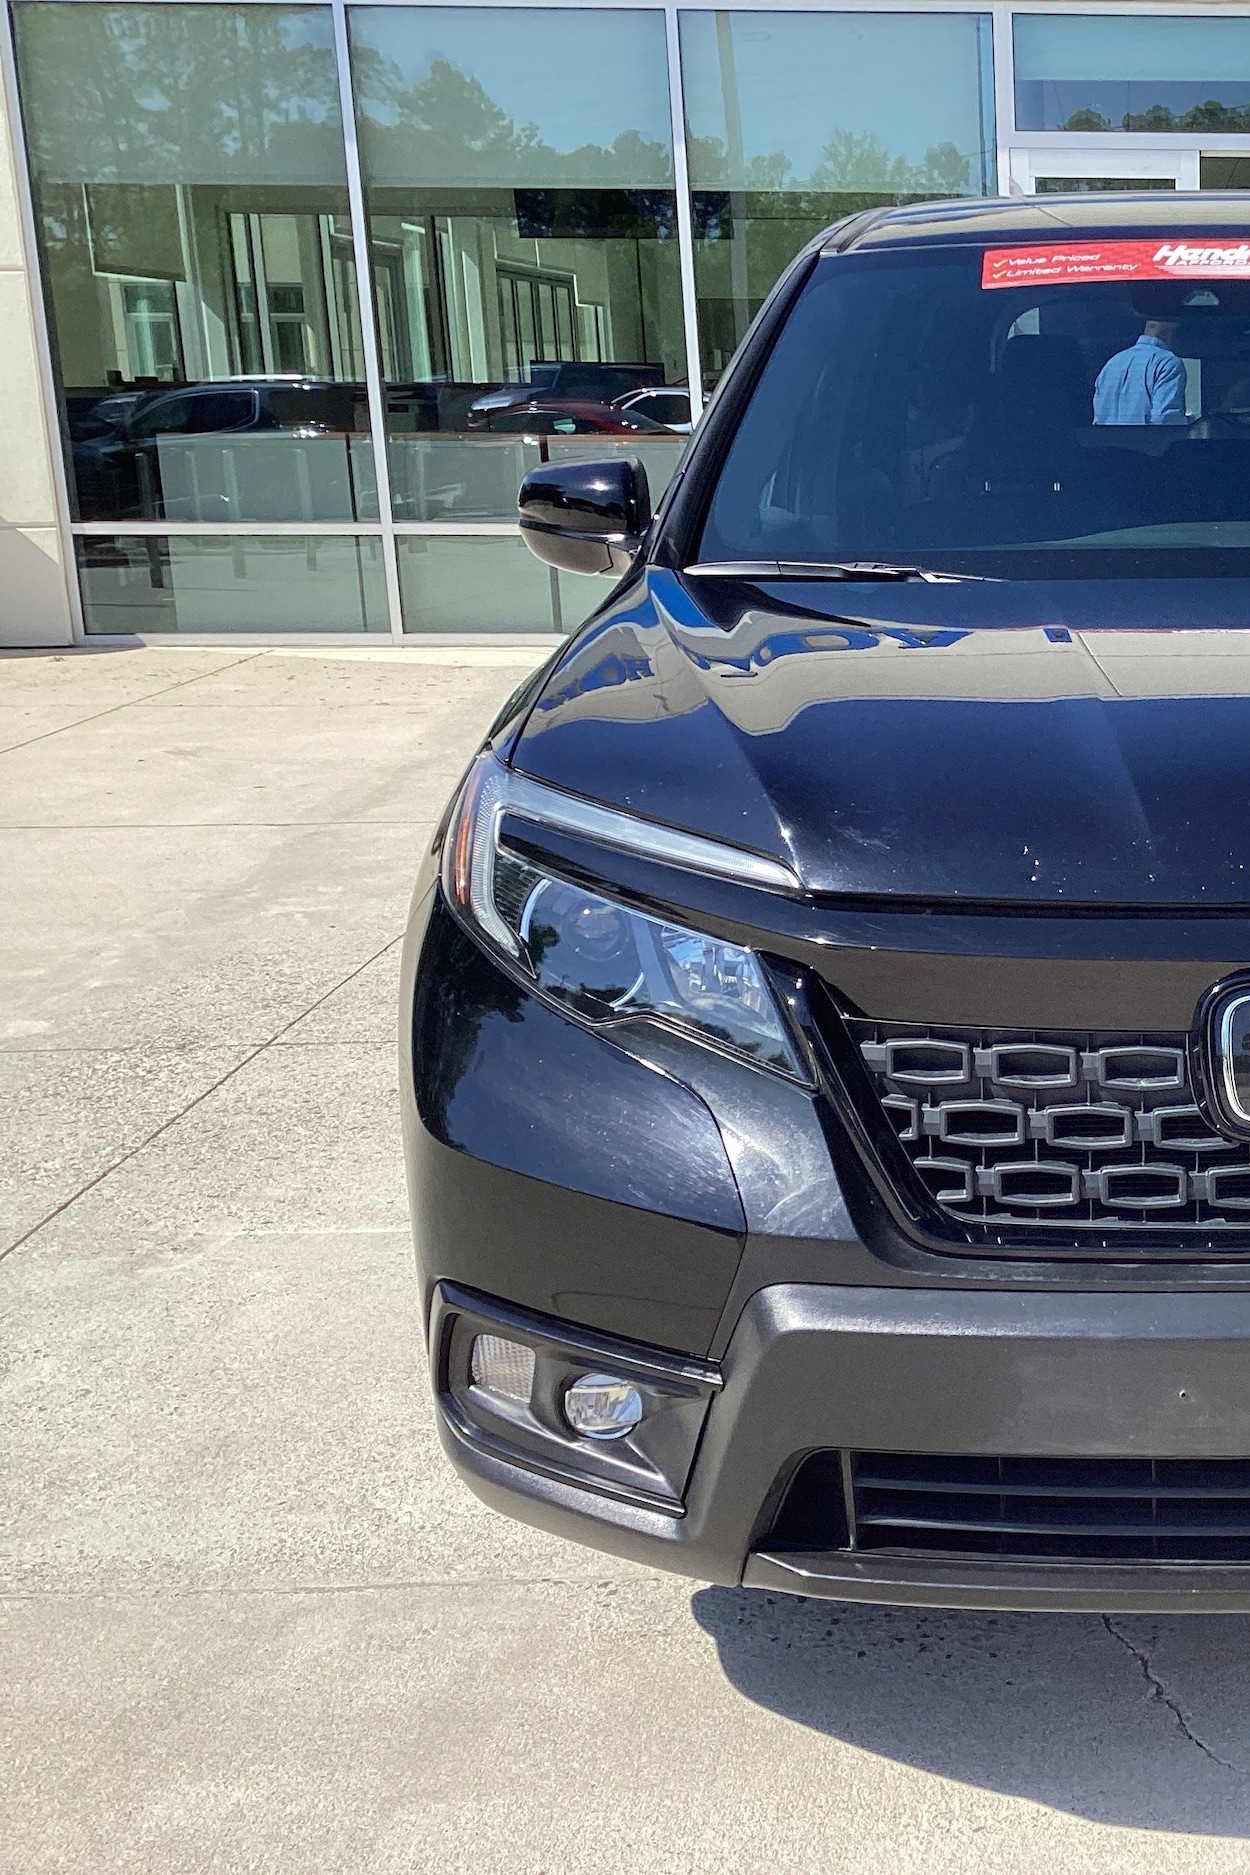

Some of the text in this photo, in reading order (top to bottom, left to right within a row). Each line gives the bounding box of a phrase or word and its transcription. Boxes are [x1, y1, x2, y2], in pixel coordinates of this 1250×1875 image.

[1008, 253, 1100, 266] Value Priced
[1006, 264, 1138, 277] Limited Warranty
